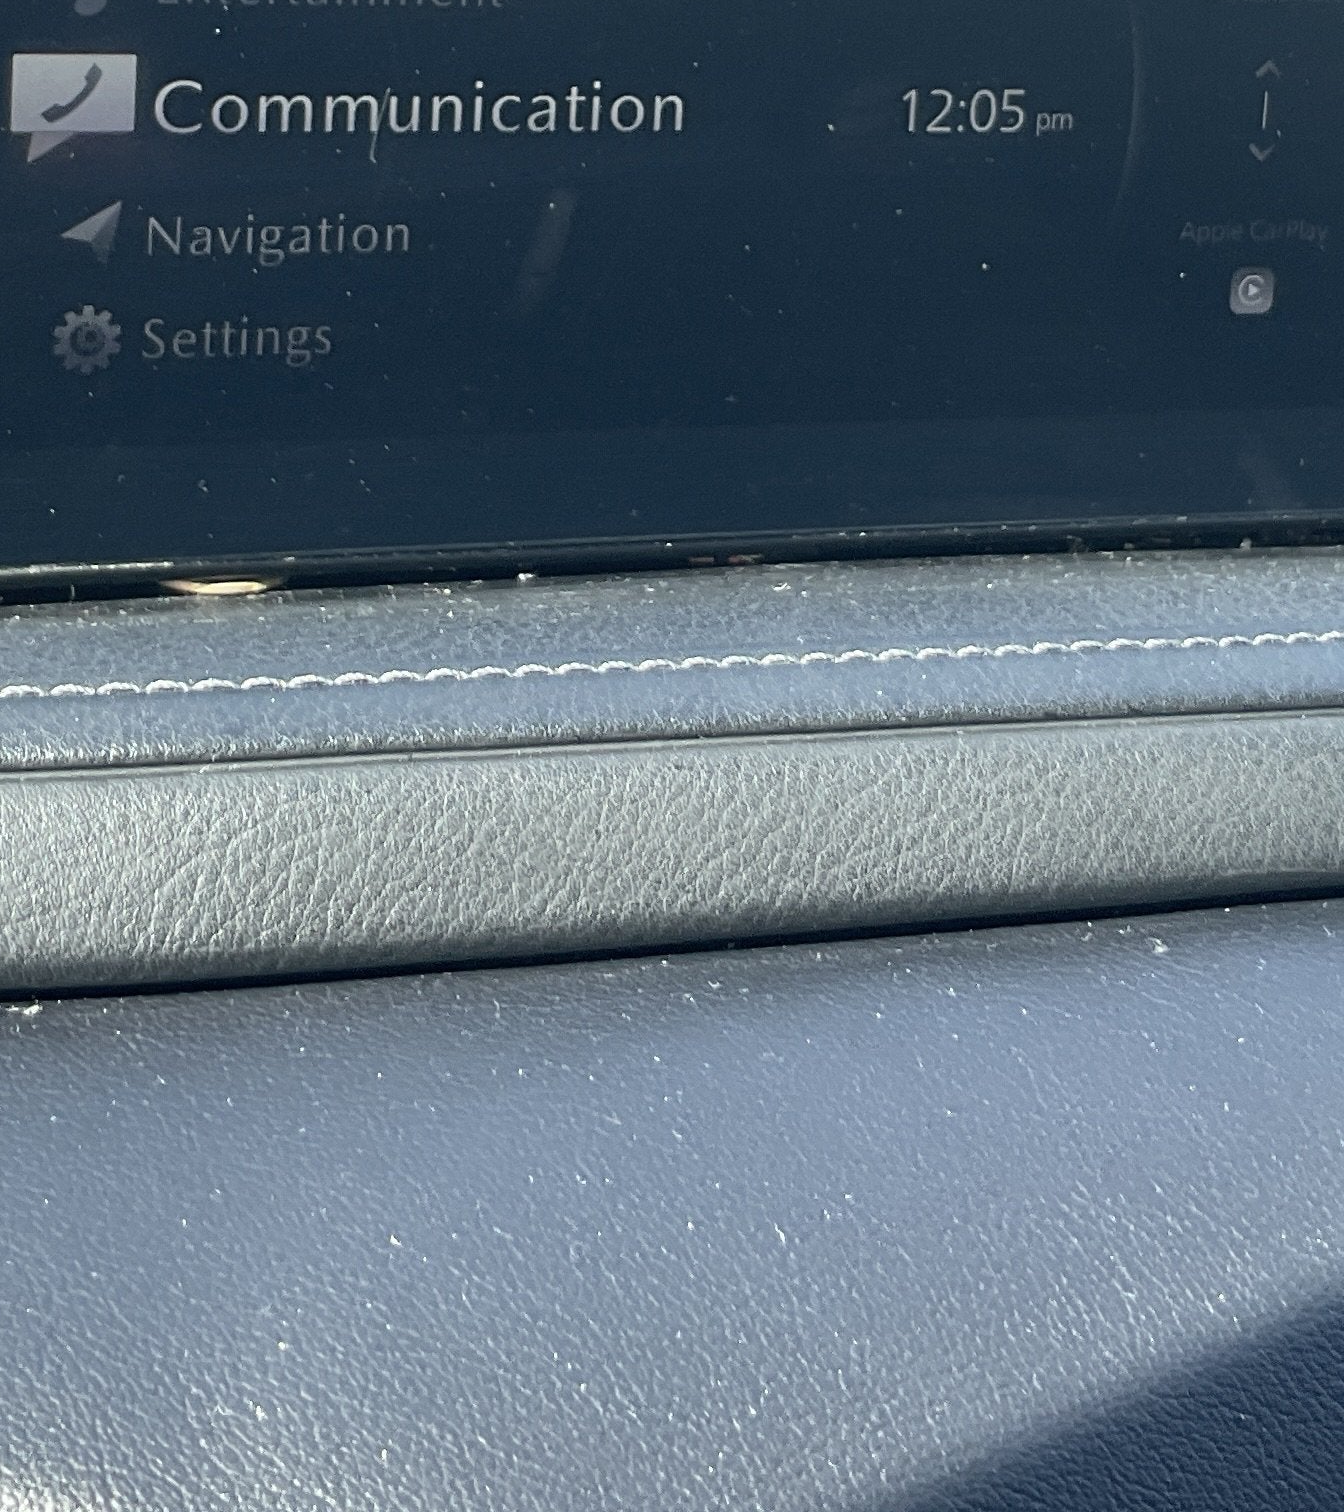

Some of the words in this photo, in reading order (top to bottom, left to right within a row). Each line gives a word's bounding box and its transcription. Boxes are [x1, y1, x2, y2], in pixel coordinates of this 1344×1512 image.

[154, 79, 686, 135] Communication
[902, 88, 1026, 133] 12:05
[1035, 111, 1074, 136] pm
[145, 214, 411, 266] Navigation
[1179, 220, 1243, 246] Apple
[141, 316, 334, 369] Settings
